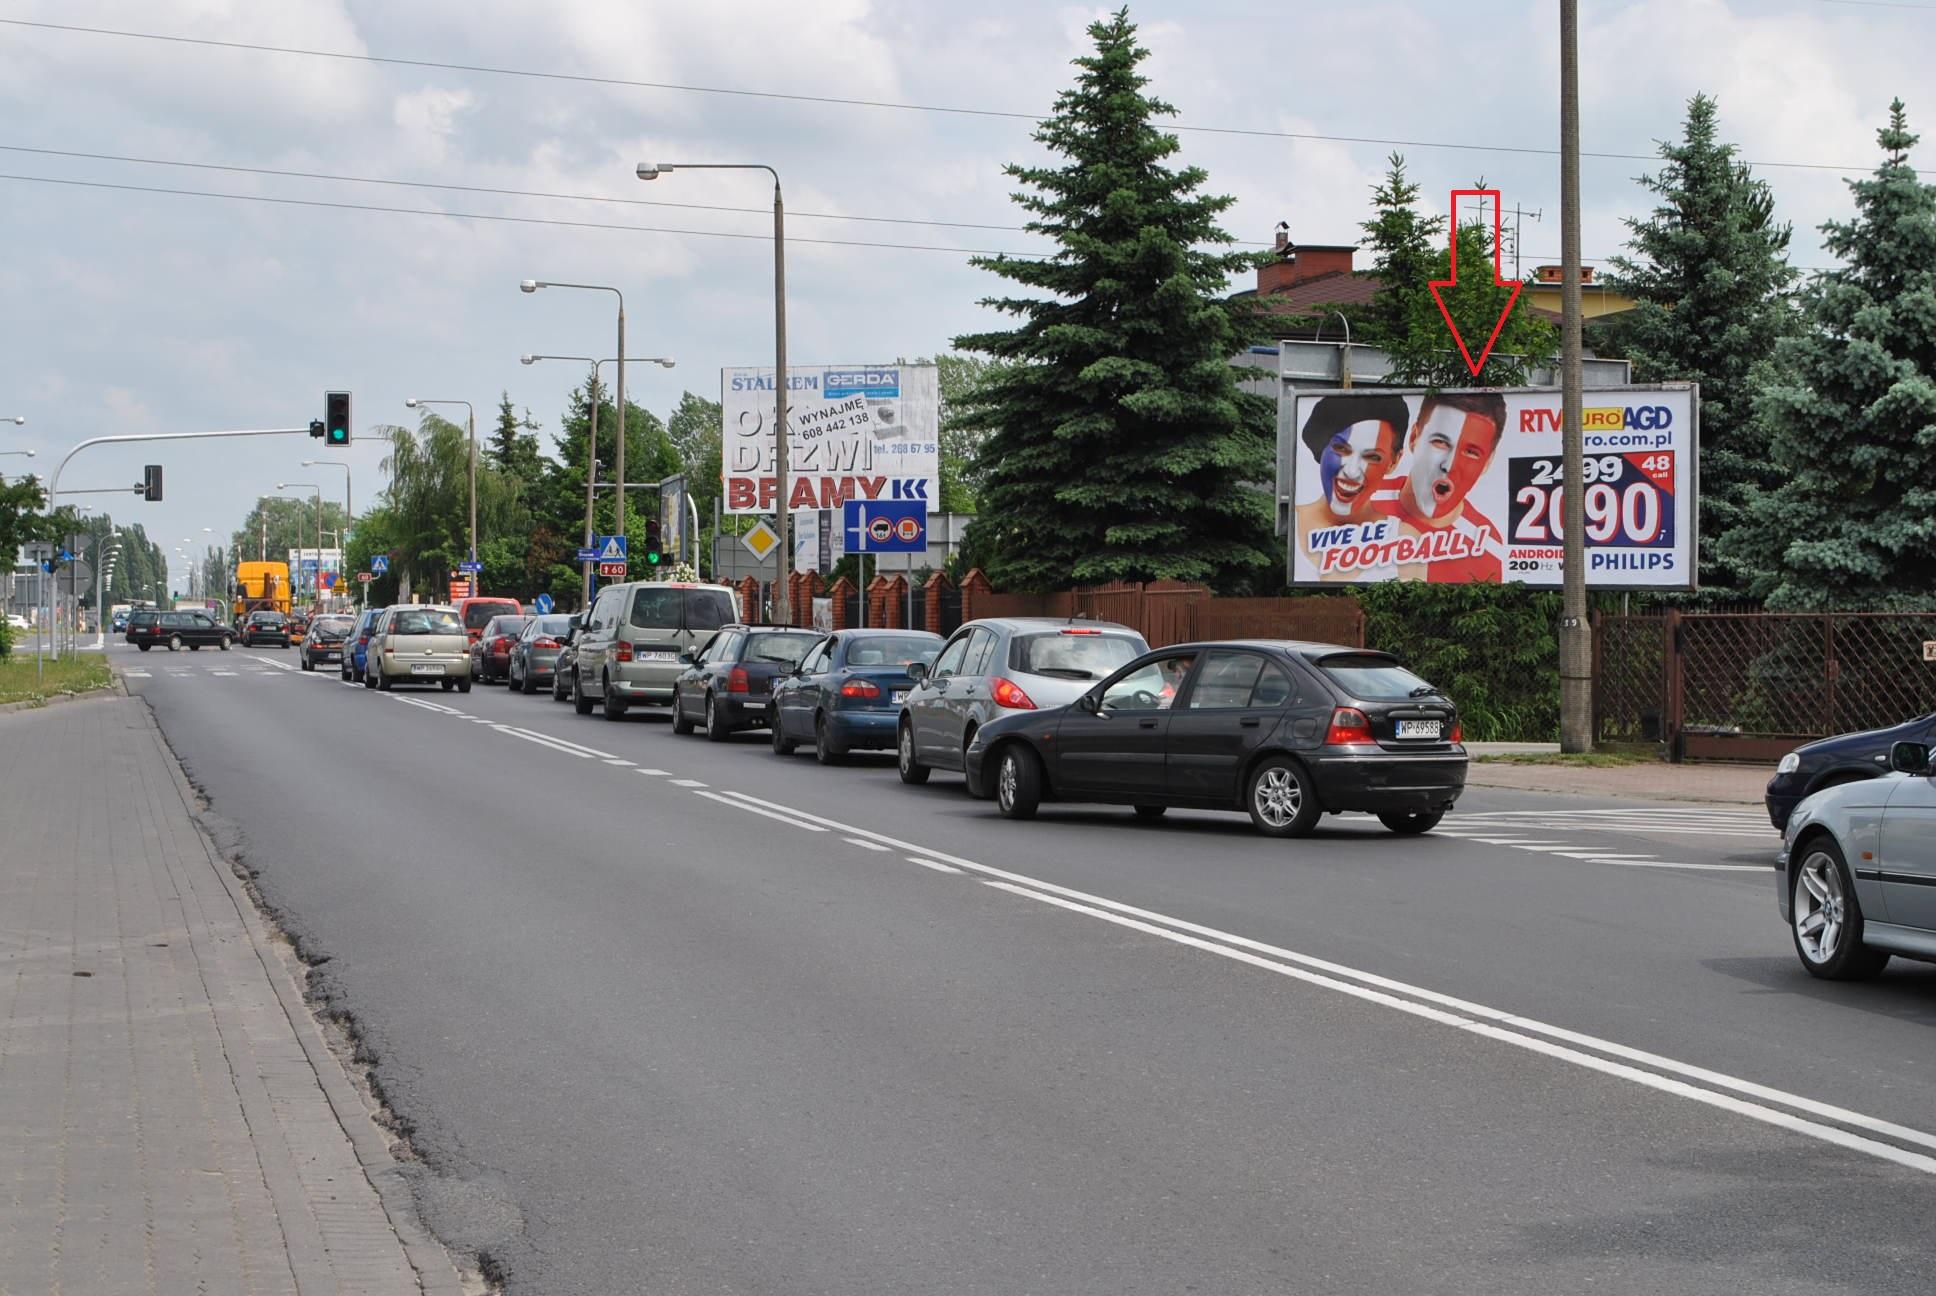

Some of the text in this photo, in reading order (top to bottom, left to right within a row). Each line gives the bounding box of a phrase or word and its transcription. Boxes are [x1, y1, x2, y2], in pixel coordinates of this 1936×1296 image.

[827, 373, 895, 386] GERDA
[799, 398, 865, 426] WYNAJMĘ
[1623, 406, 1672, 430] AGD
[802, 412, 869, 440] 608 442 138
[924, 443, 936, 453] 95
[1584, 432, 1672, 448] ro.com.pl
[1641, 455, 1670, 471] 48
[1311, 524, 1387, 549] VIVE LE
[1509, 561, 1539, 571] 200
[1591, 553, 1674, 570] PHILIPS
[611, 566, 623, 574] 60
[1401, 721, 1412, 734] WP
